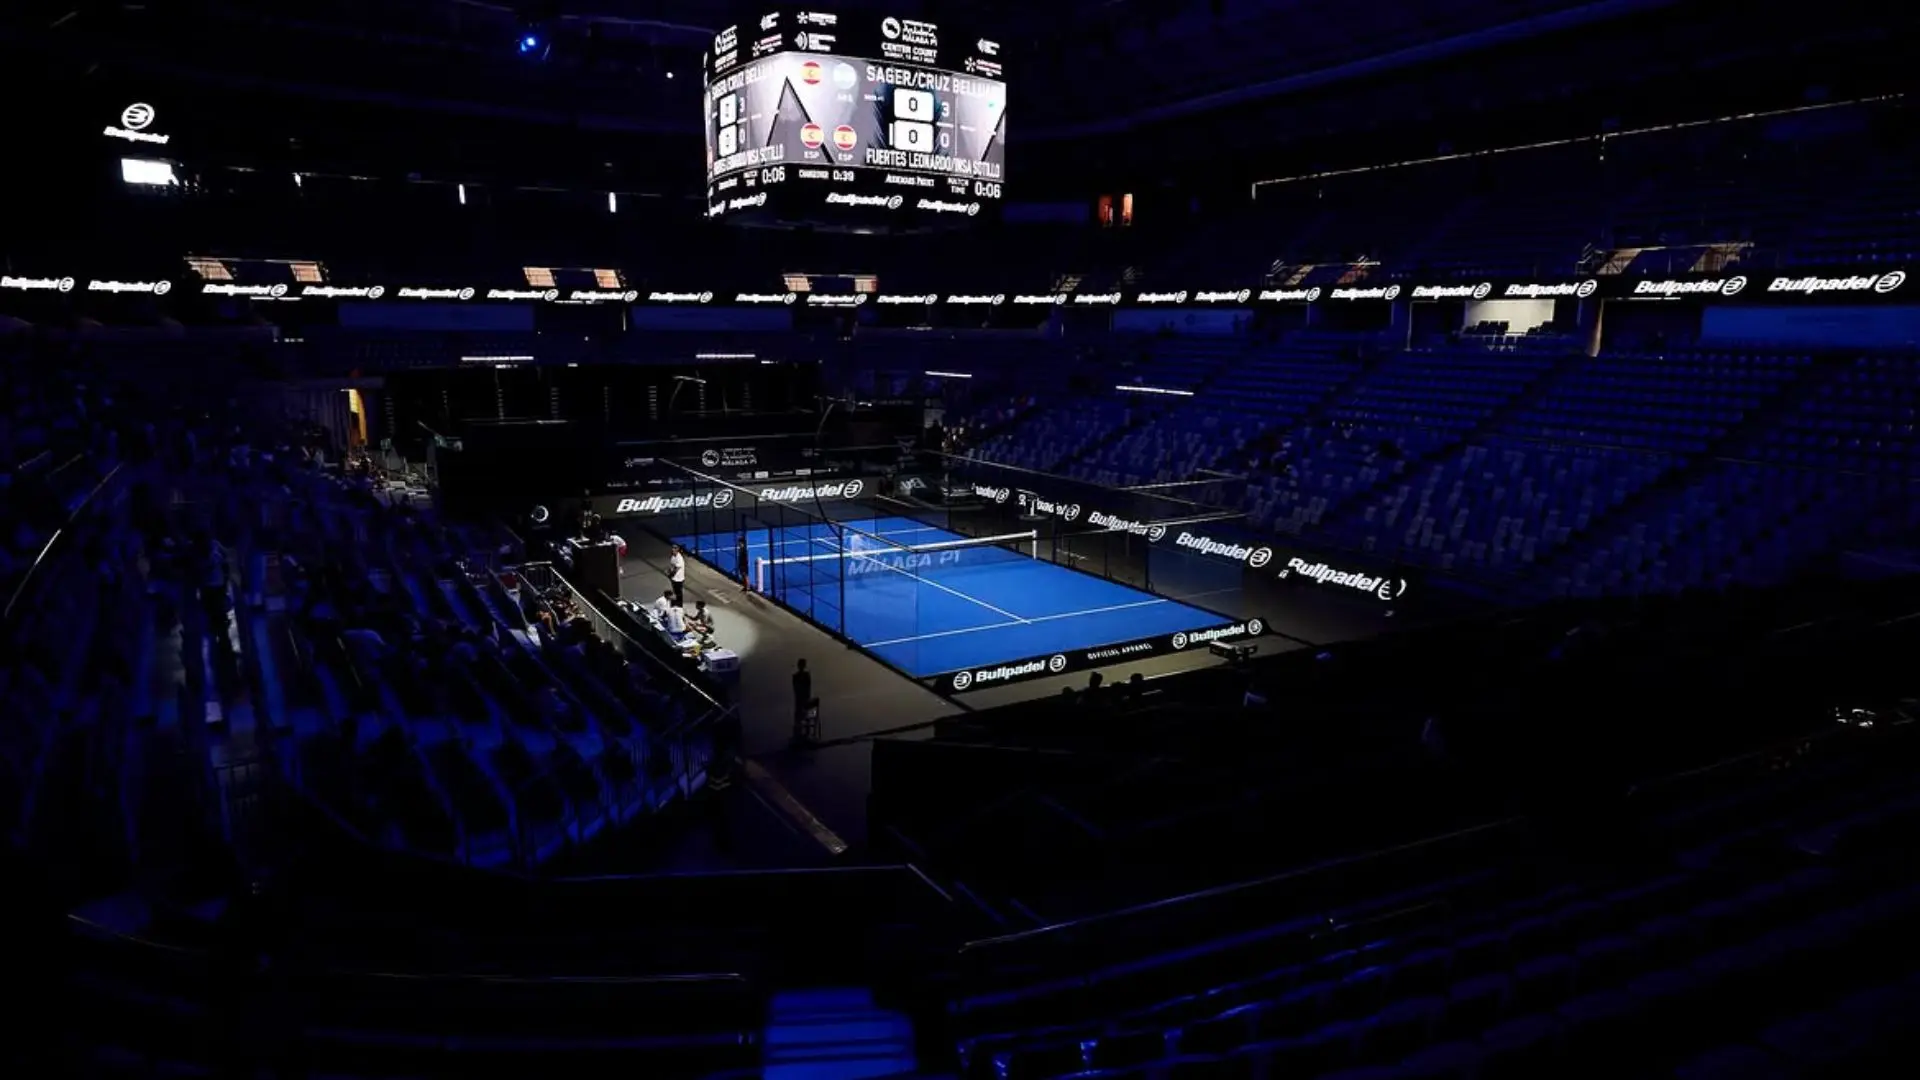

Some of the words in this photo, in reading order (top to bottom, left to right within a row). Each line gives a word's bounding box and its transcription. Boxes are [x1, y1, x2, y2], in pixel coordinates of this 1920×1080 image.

[866, 65, 951, 93] SAGER/CRUZ
[909, 97, 918, 112] 0
[941, 101, 950, 117] 3
[909, 130, 918, 144] 0
[941, 133, 950, 148] 0
[866, 148, 907, 168] FUERTES
[974, 181, 1001, 199] 0:06
[1412, 285, 1475, 299] Bullpadel
[1505, 283, 1578, 298] Bullpadel
[1634, 279, 1724, 296] Bullpadel
[1768, 275, 1877, 294] Bullpadel
[1331, 287, 1386, 301] Bullpadel
[757, 483, 845, 502] Bullpadel
[616, 493, 713, 513] Bullpadel
[1176, 532, 1252, 561] Bullpadel
[1286, 557, 1381, 592] Bullpadel
[1188, 624, 1245, 643] Bullpadel
[976, 660, 1046, 683] Bullpadel
